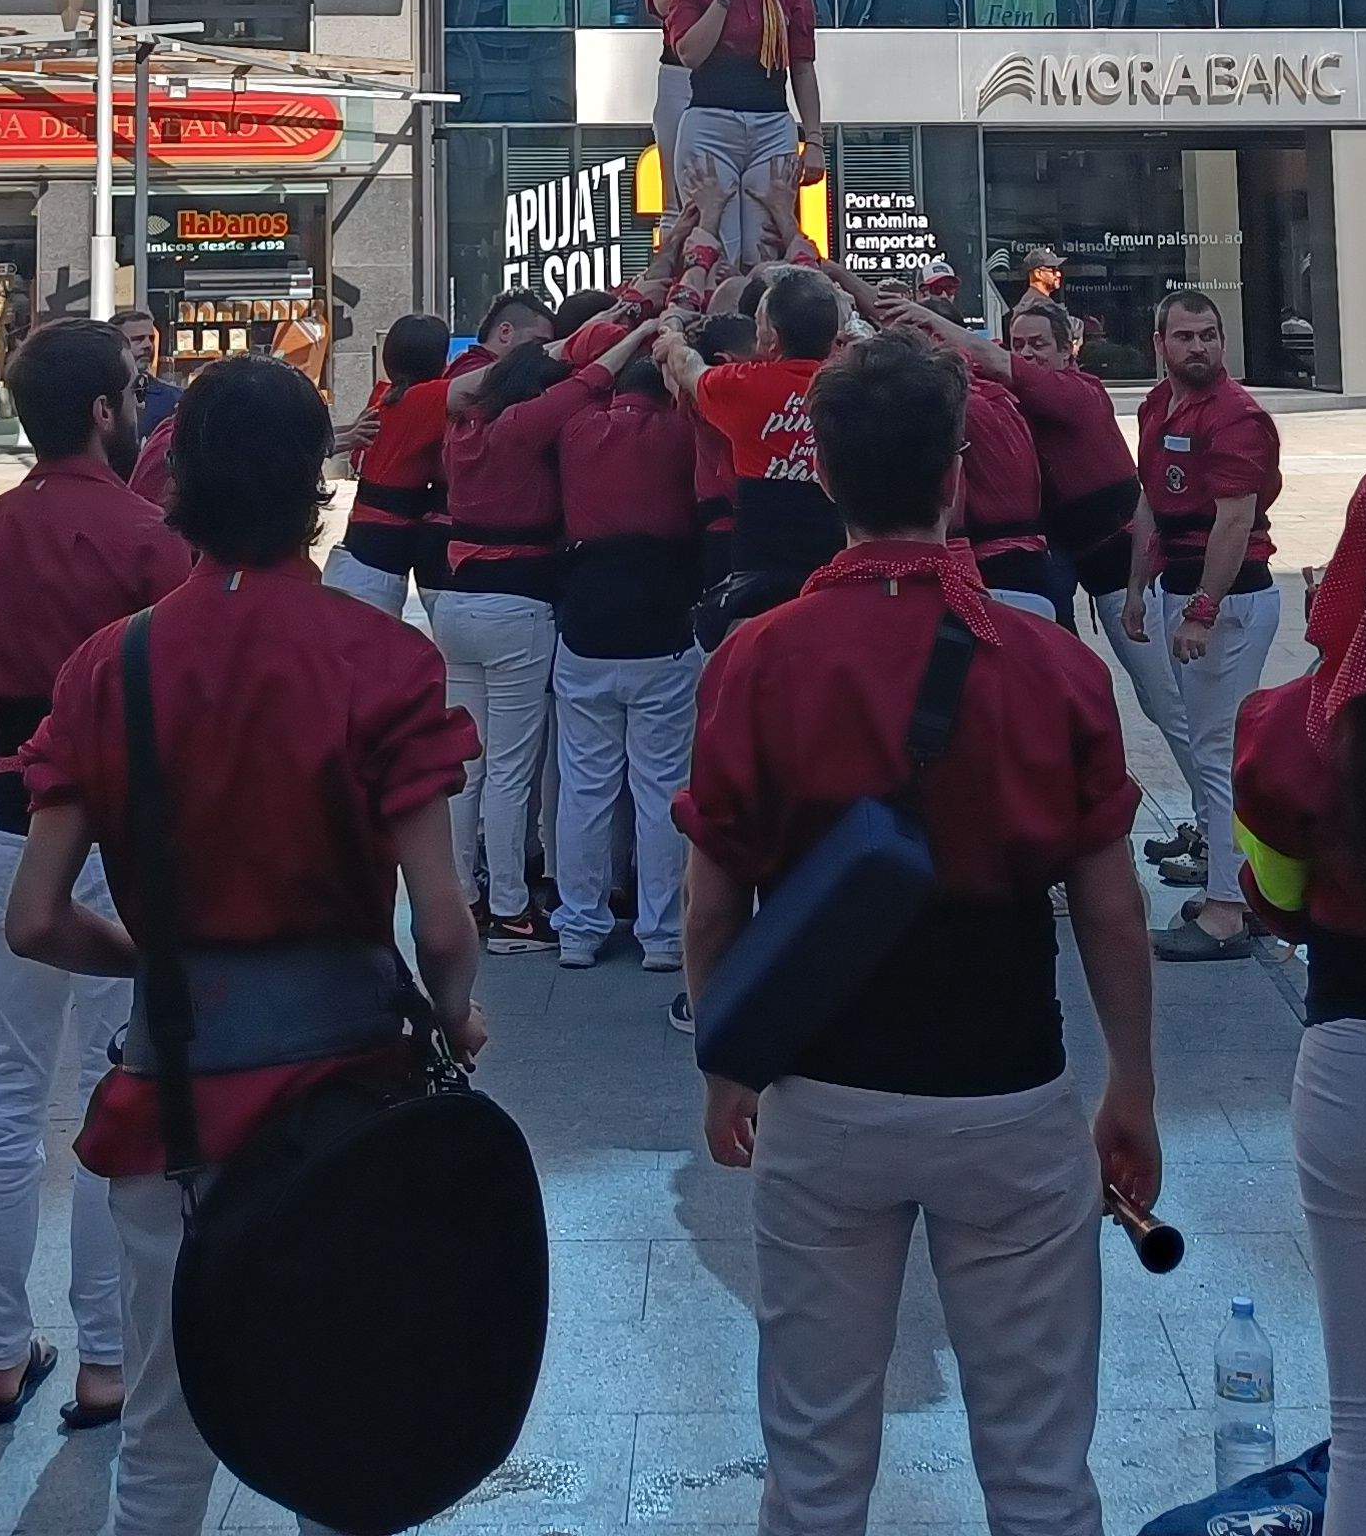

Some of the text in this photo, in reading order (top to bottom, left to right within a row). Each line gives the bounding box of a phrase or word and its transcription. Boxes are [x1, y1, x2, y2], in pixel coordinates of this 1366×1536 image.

[1039, 52, 1347, 107] MORABANC
[504, 156, 627, 260] APUJA'T
[844, 192, 916, 209] Porta'ns
[177, 210, 290, 239] Habanos
[845, 212, 929, 229] la nòmina
[198, 240, 245, 252] desde
[249, 240, 286, 251] 1492
[855, 233, 937, 253] emporta't
[844, 253, 878, 270] fins
[880, 256, 892, 270] a
